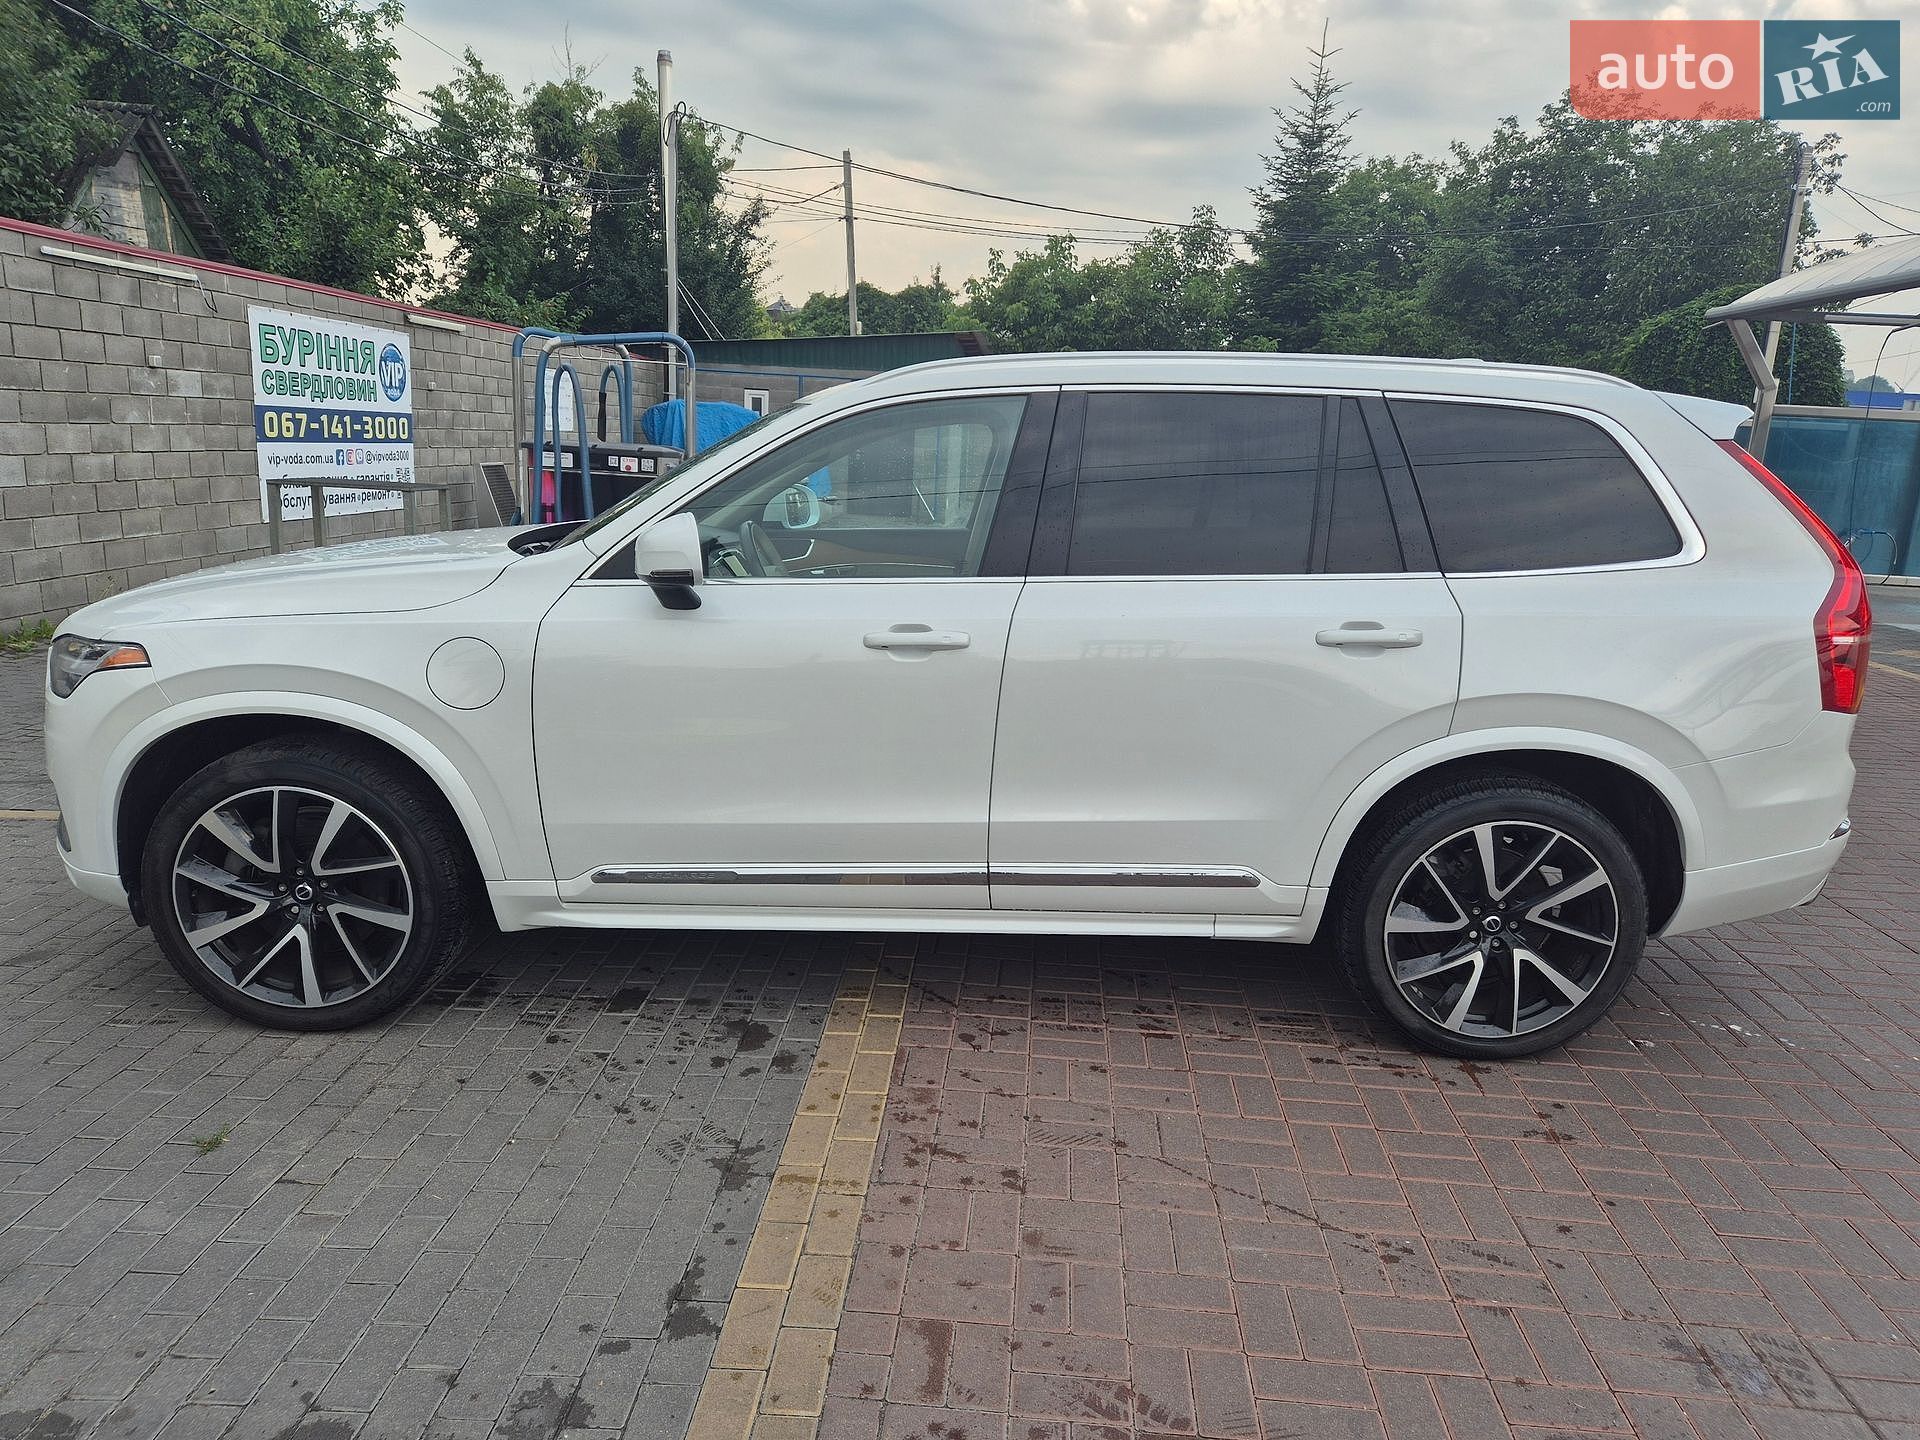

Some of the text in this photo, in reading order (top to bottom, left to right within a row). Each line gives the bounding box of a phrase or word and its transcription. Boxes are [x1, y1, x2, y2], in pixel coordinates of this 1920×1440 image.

[258, 323, 376, 376] БУРІННЯ
[261, 368, 378, 403] СВЕРДЛОВИН
[380, 360, 404, 388] VIP
[263, 411, 409, 440] 067-141-3000
[267, 452, 334, 467] vip-voda.com.ua
[365, 450, 410, 464] @vipvoda3000
[361, 490, 391, 504] ремонт
